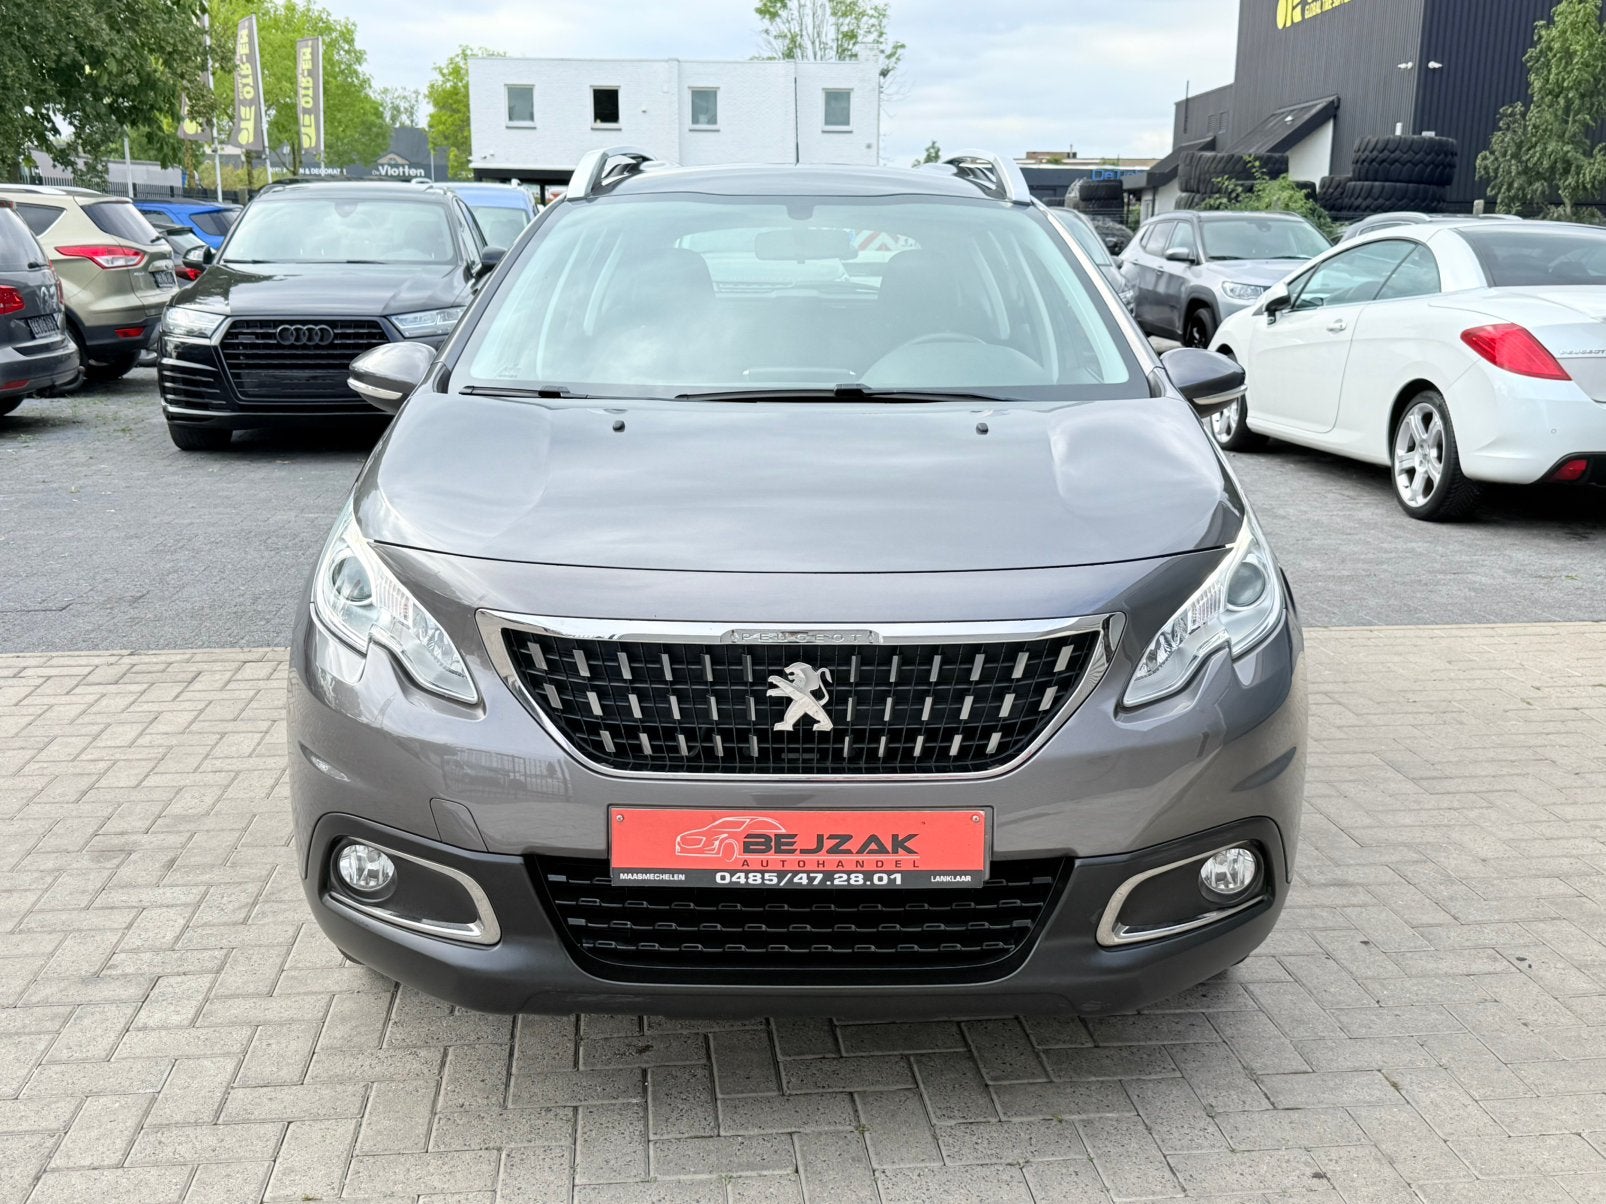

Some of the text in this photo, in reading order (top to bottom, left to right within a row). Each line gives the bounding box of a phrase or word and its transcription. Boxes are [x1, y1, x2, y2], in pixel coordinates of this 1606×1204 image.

[378, 164, 425, 177] Vlotten
[741, 632, 863, 643] PEUGEOT
[742, 833, 920, 854] BEJZAK
[741, 859, 920, 869] AUTOHANDEL
[619, 872, 686, 881] MAASMECHELEN
[715, 871, 902, 886] 0485/47.28.01
